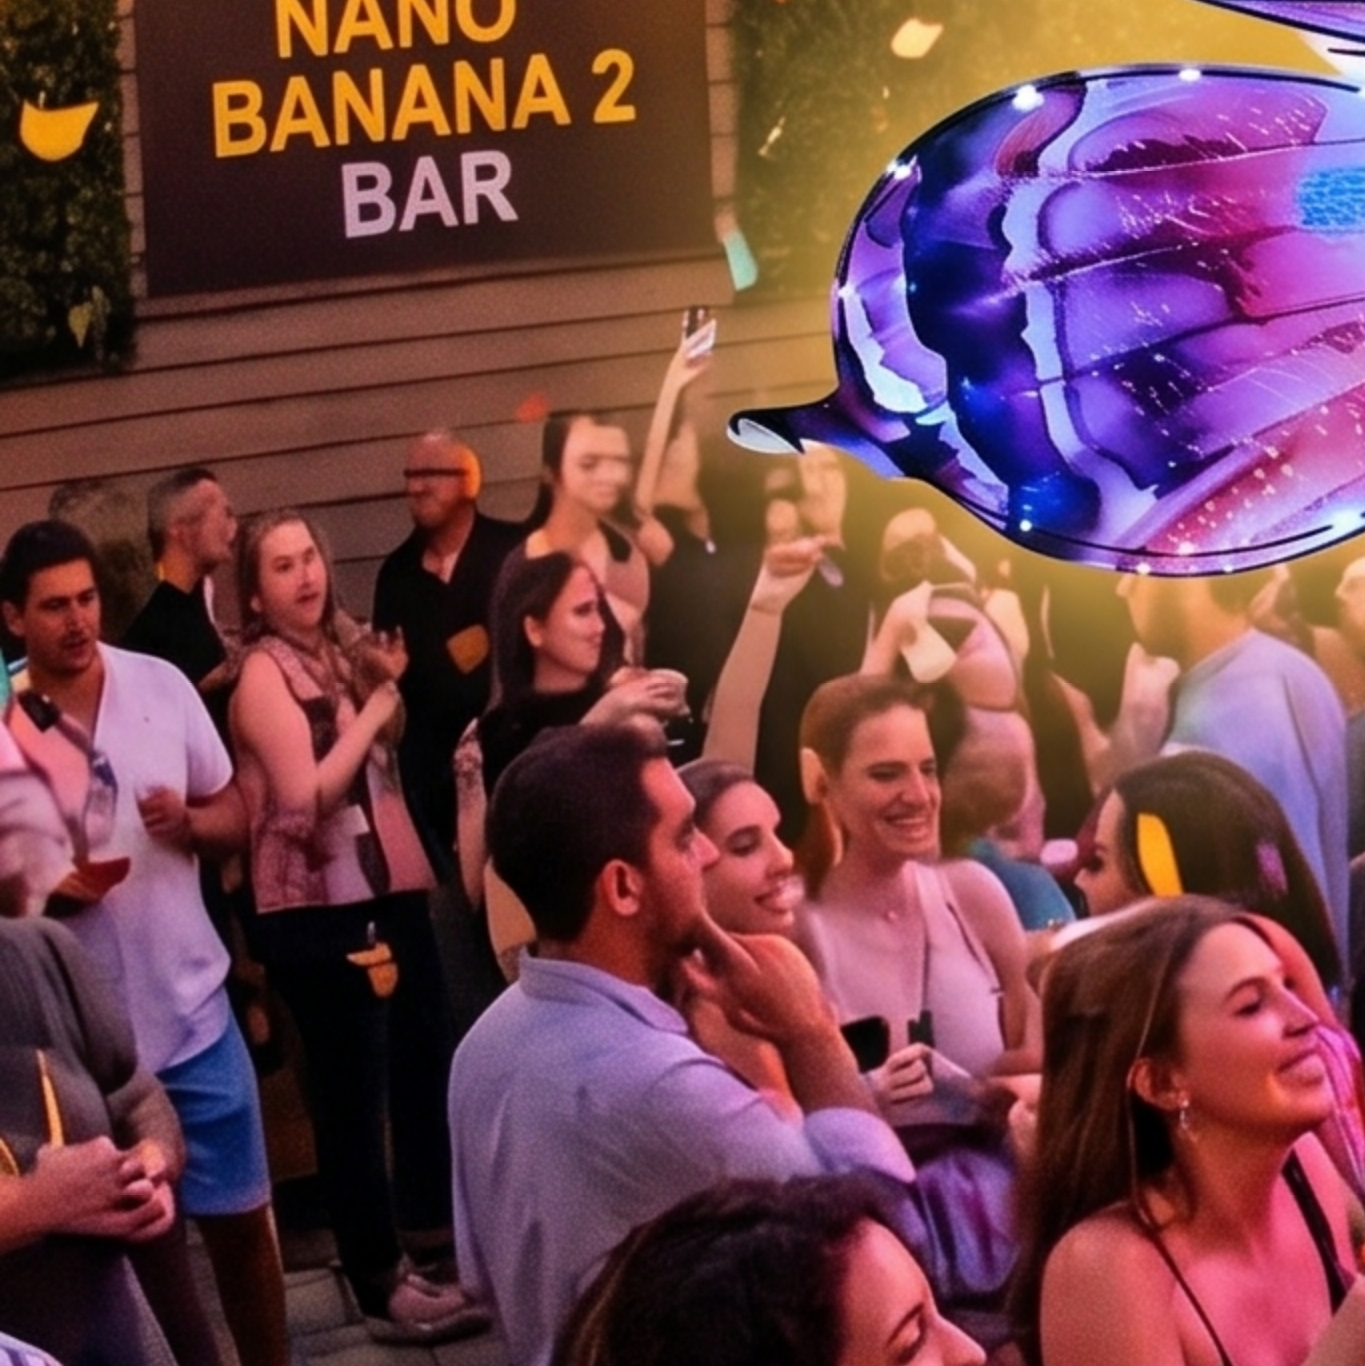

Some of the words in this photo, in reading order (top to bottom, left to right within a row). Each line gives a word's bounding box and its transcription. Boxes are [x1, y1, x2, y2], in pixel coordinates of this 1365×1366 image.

[211, 53, 571, 158] BANANA
[590, 49, 637, 124] 2
[341, 150, 519, 238] BAR
